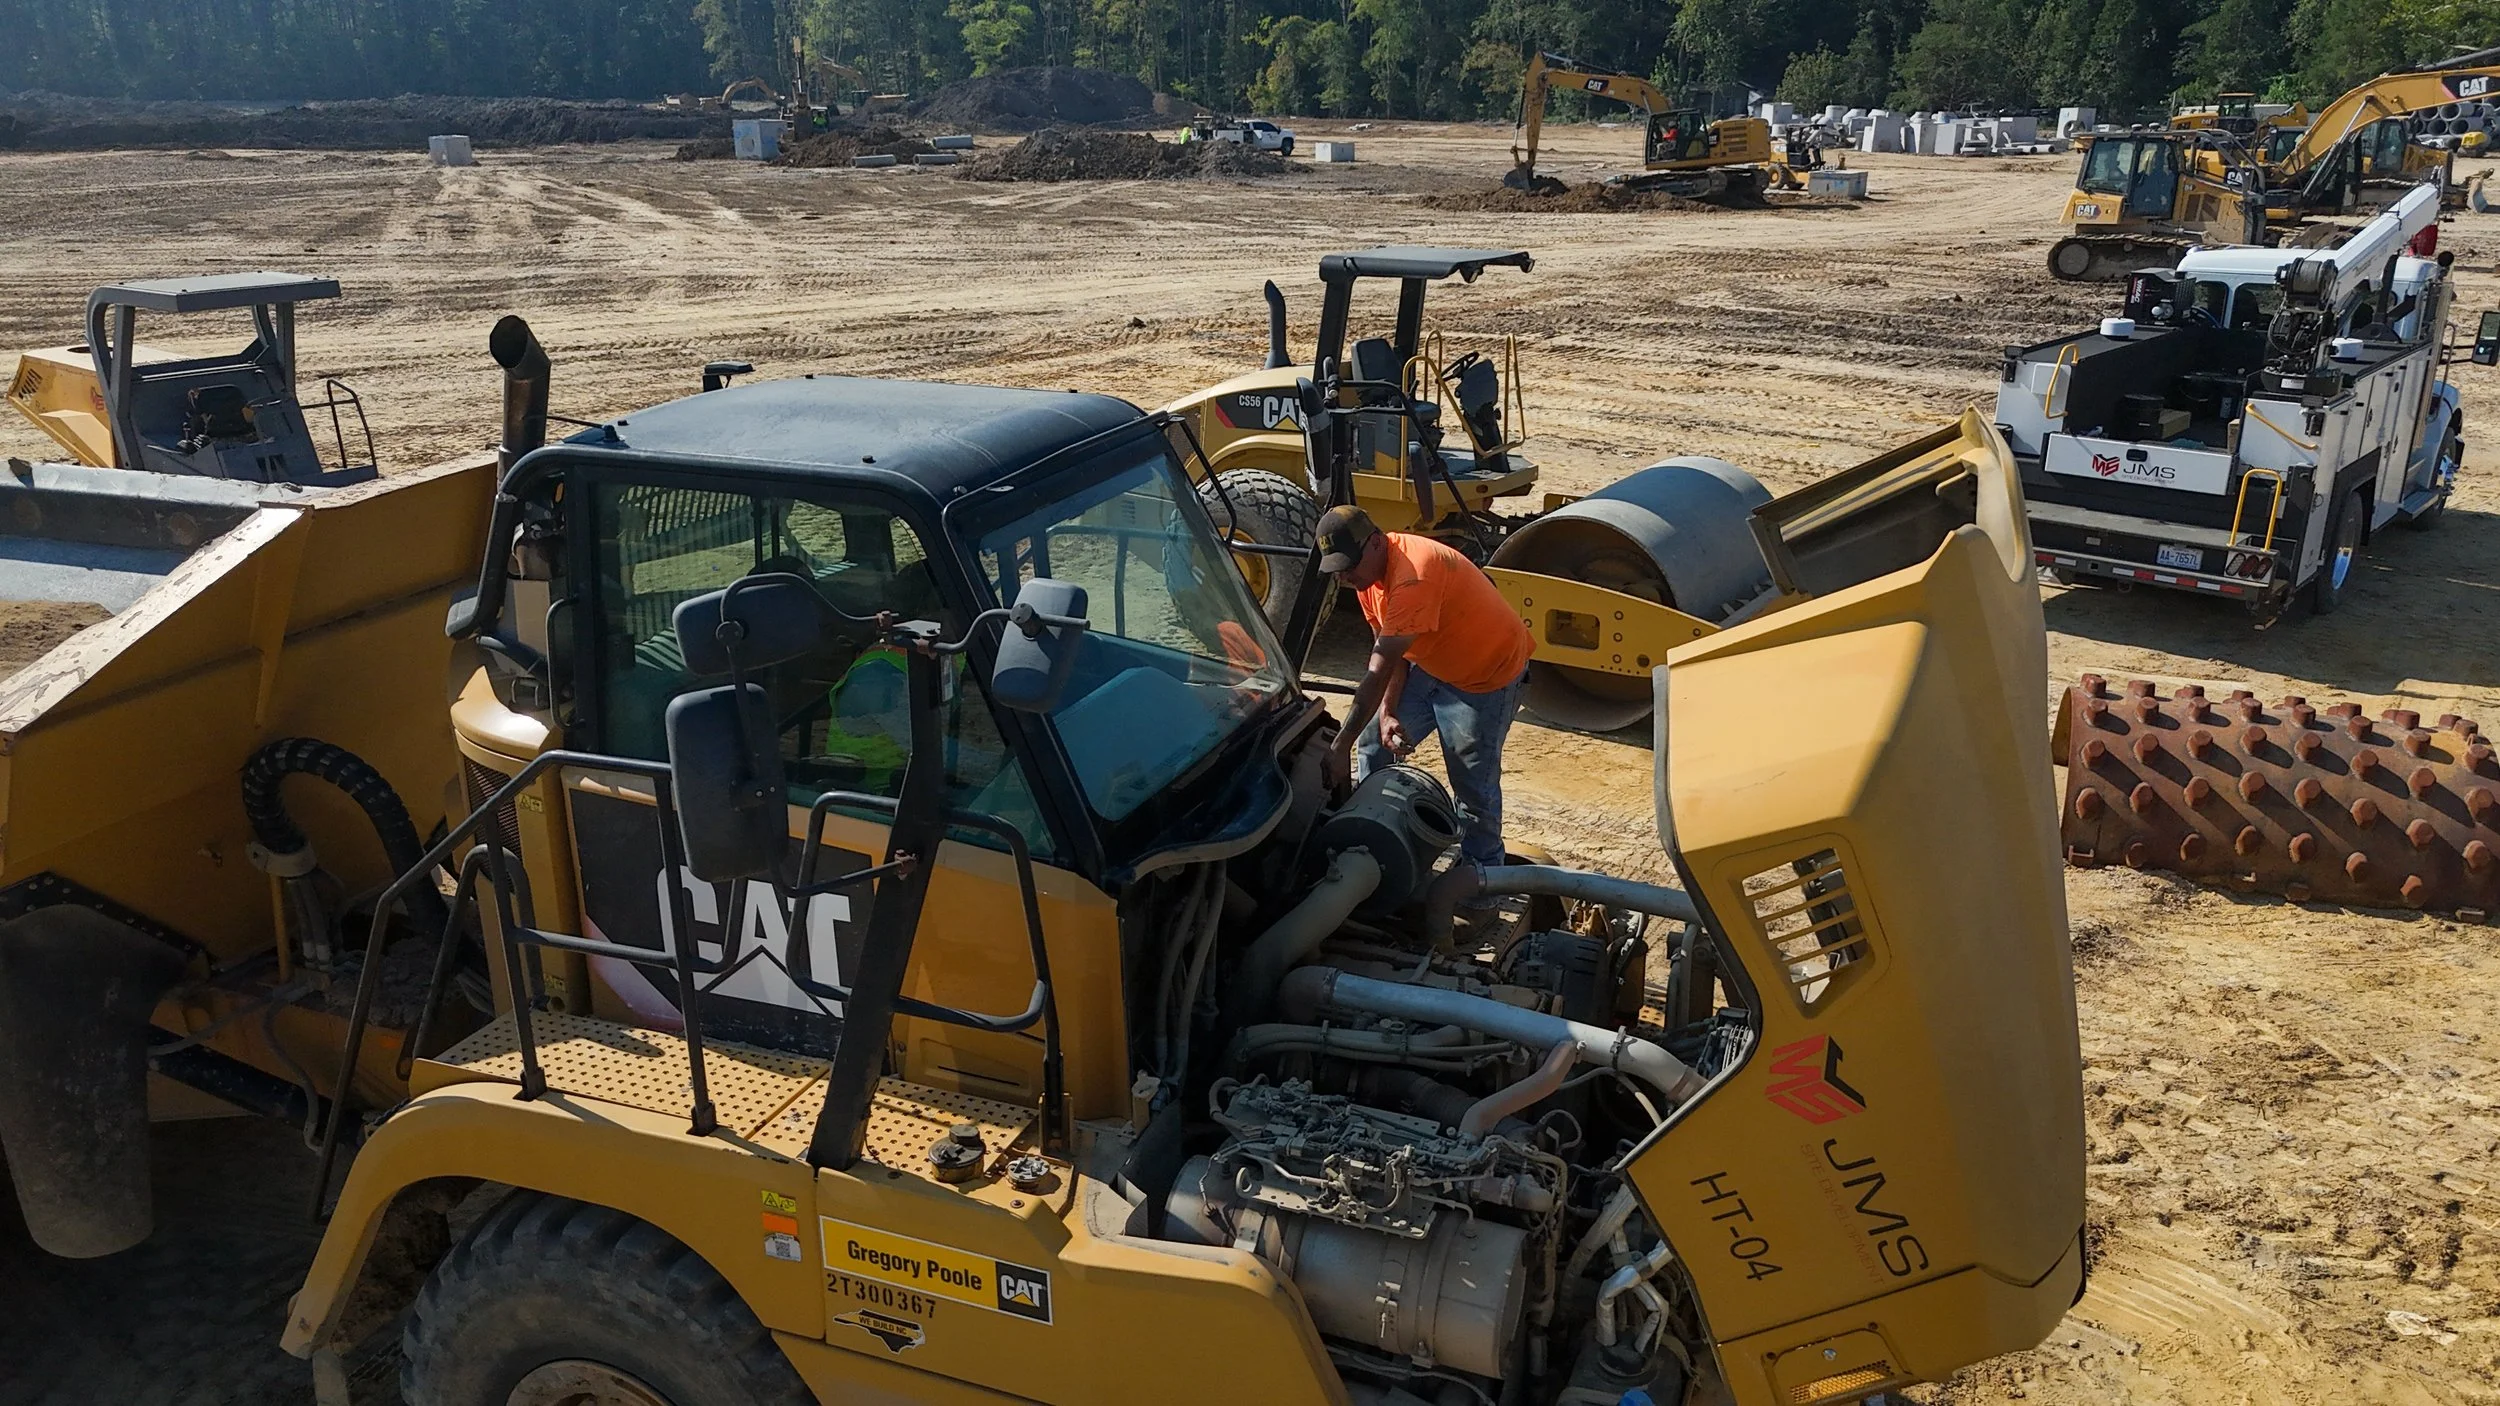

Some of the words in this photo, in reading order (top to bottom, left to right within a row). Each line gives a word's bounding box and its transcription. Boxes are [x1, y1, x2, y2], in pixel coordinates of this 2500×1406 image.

[1587, 80, 1603, 92] CAT
[2460, 77, 2489, 97] CAT
[2077, 204, 2097, 216] CAT
[1239, 395, 1261, 407] CS56
[2123, 463, 2176, 479] JMS
[657, 865, 851, 1018] CAT
[1823, 1138, 1929, 1277] JMS
[1690, 1171, 1783, 1280] HT-04
[848, 1240, 921, 1278] Gregory
[927, 1259, 982, 1291] Poole
[1000, 1274, 1045, 1308] CAT
[826, 1273, 936, 1319] 2T300367
[858, 1316, 871, 1325] WE
[873, 1320, 895, 1332] BUILD
[896, 1325, 907, 1335] NC
